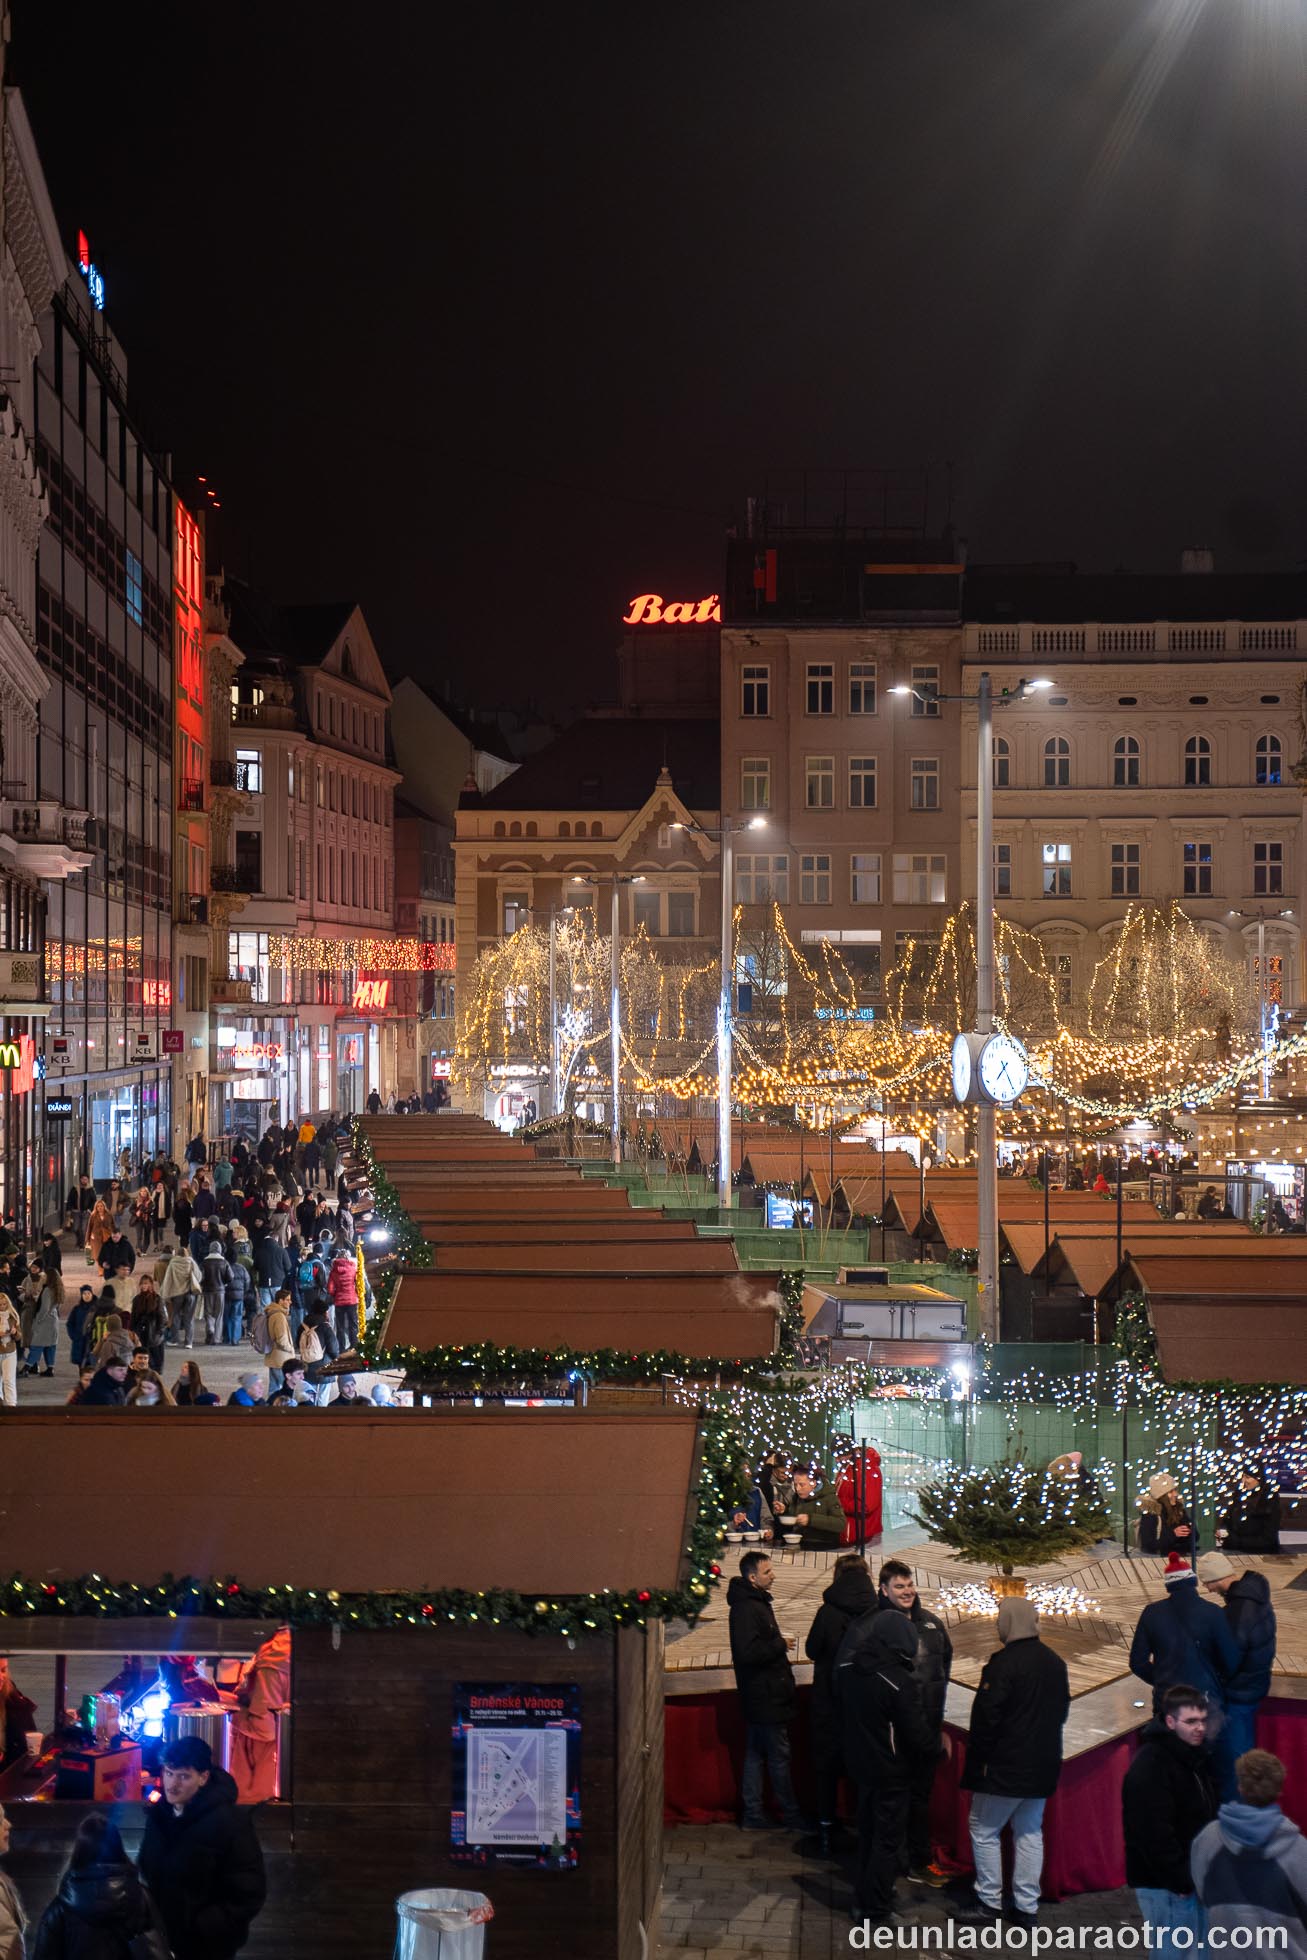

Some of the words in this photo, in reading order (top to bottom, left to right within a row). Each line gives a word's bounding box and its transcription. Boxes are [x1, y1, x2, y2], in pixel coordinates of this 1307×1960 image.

[352, 980, 389, 1008] H&M
[135, 1047, 152, 1055] KB
[50, 1056, 71, 1064] KB
[470, 1695, 521, 1709] Brněnské
[523, 1696, 564, 1709] Vánoce
